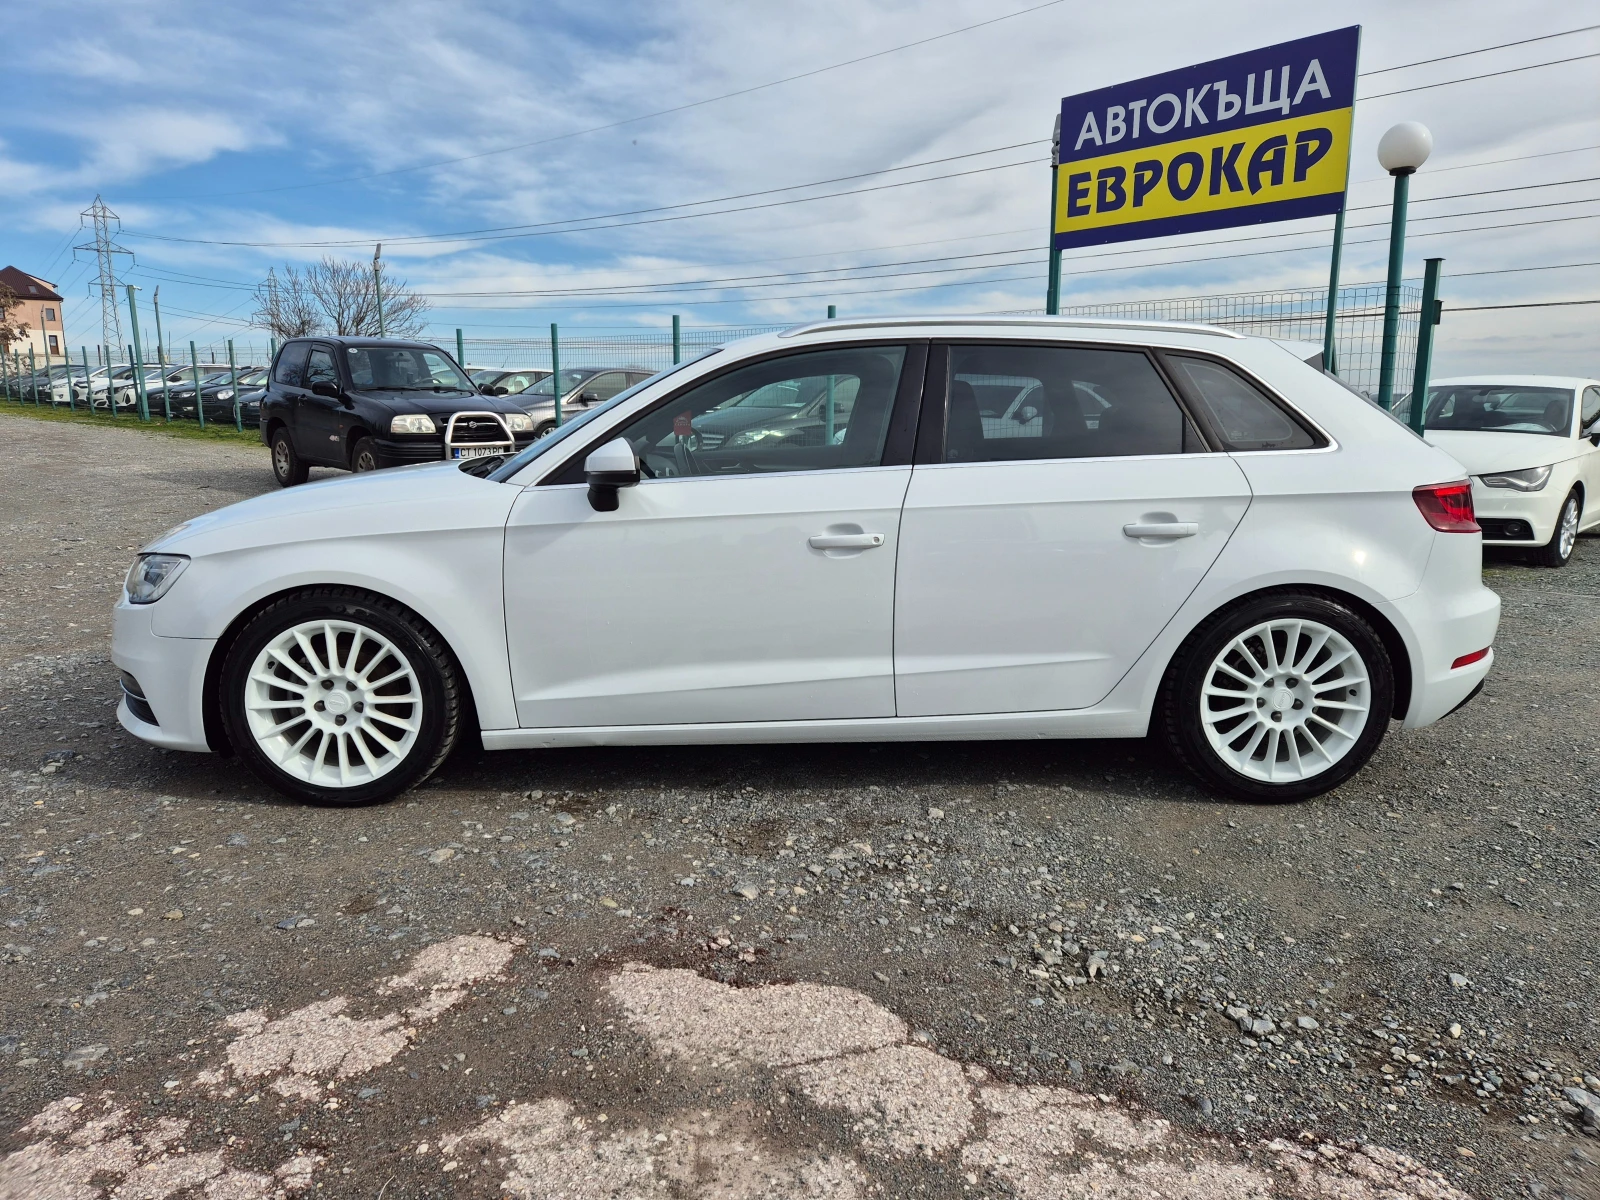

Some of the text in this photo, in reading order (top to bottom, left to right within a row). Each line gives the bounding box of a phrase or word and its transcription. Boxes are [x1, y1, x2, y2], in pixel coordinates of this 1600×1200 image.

[1074, 58, 1332, 150] АВТОКЪЩА
[1066, 127, 1333, 218] ЕВРОКАР
[460, 448, 471, 457] CT
[473, 447, 491, 457] 1073
